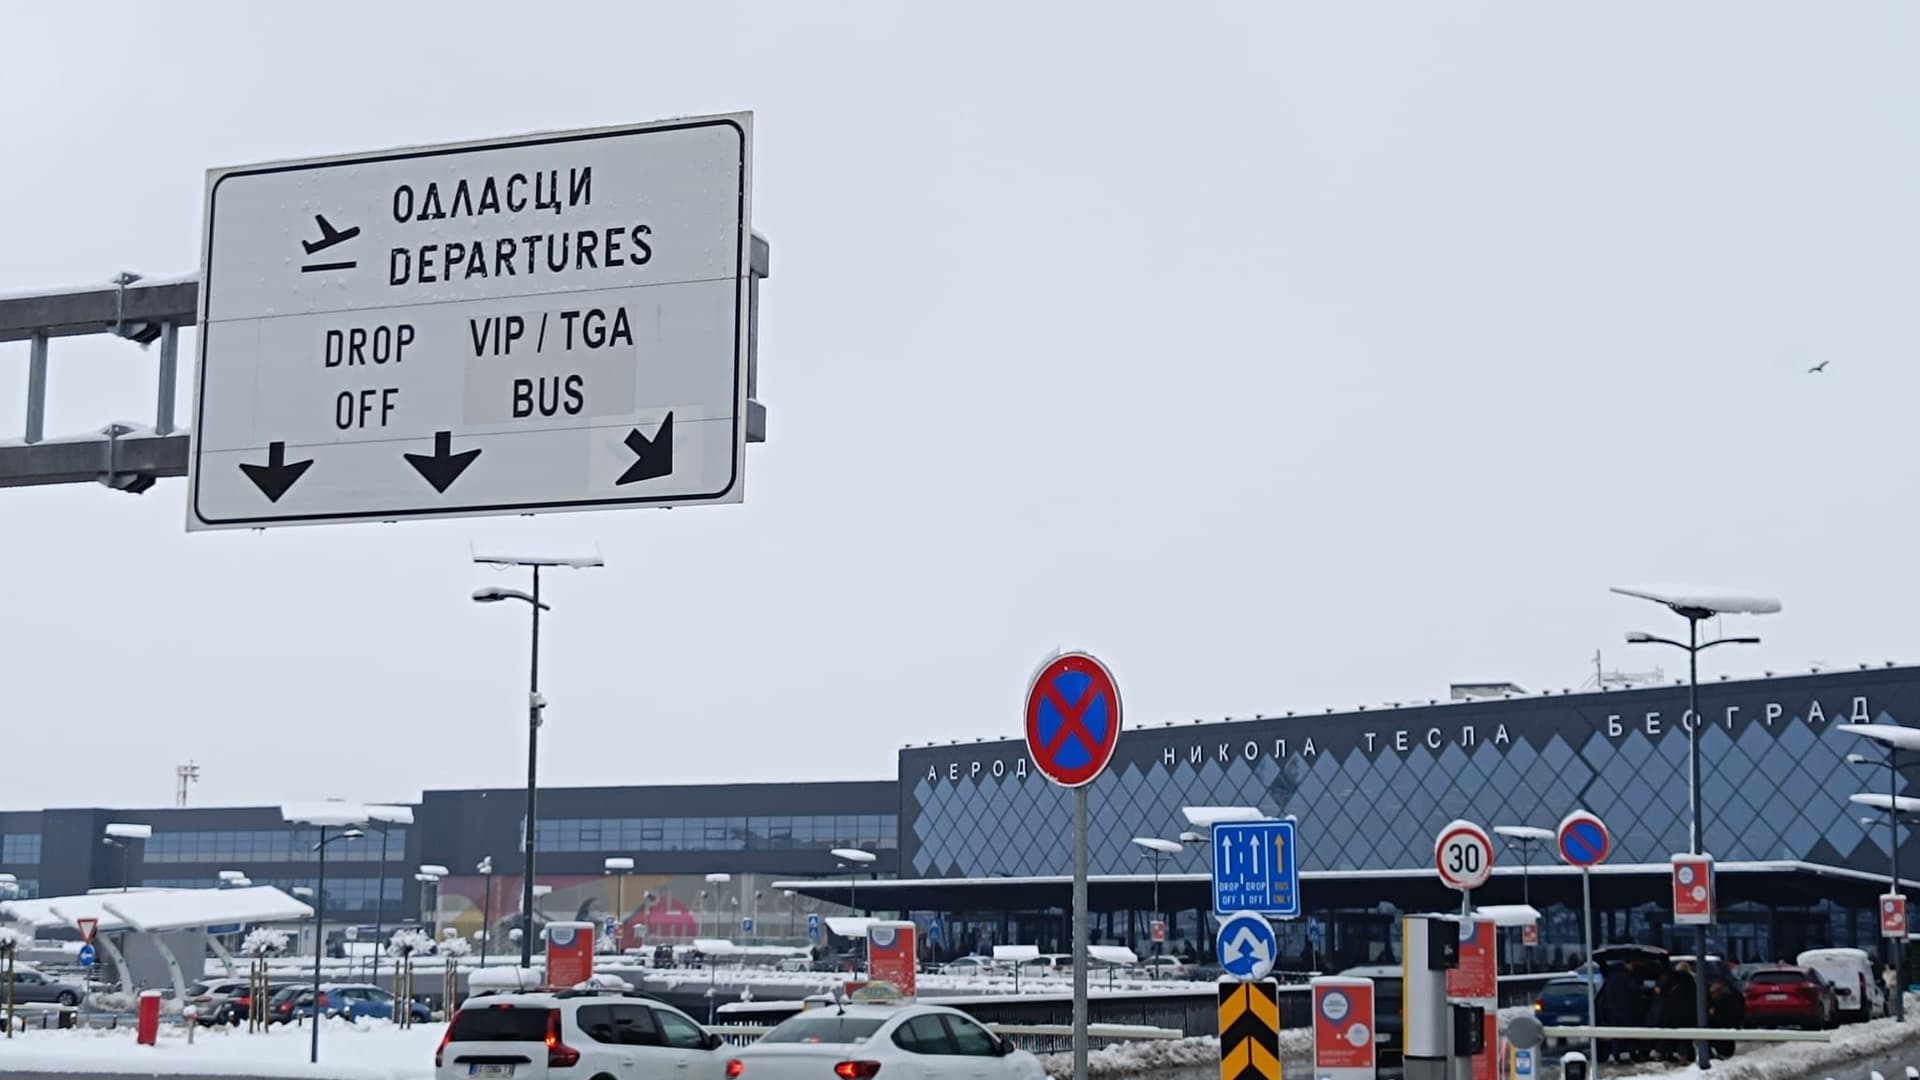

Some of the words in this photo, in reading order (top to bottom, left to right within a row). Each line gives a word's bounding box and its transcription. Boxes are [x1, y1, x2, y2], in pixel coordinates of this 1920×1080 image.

[393, 166, 592, 224] ОДЛАСЦИ
[389, 224, 652, 286] DEPARTURES
[325, 324, 415, 368] DROP
[470, 315, 525, 357] VIP
[536, 312, 548, 354] /
[559, 306, 634, 349] TGA
[335, 387, 399, 430] OFF
[512, 374, 584, 419] BUS
[927, 757, 1028, 781] АЕРОД
[1164, 738, 1317, 765] НИКОЛА
[1364, 724, 1509, 752] ТЕСЛА
[1608, 696, 1870, 737] БЕОГРАД
[1448, 843, 1480, 874] 30
[1219, 881, 1239, 892] DROP
[1222, 895, 1237, 905] OFF
[1245, 881, 1266, 892] DROP
[1249, 895, 1263, 905] OFF
